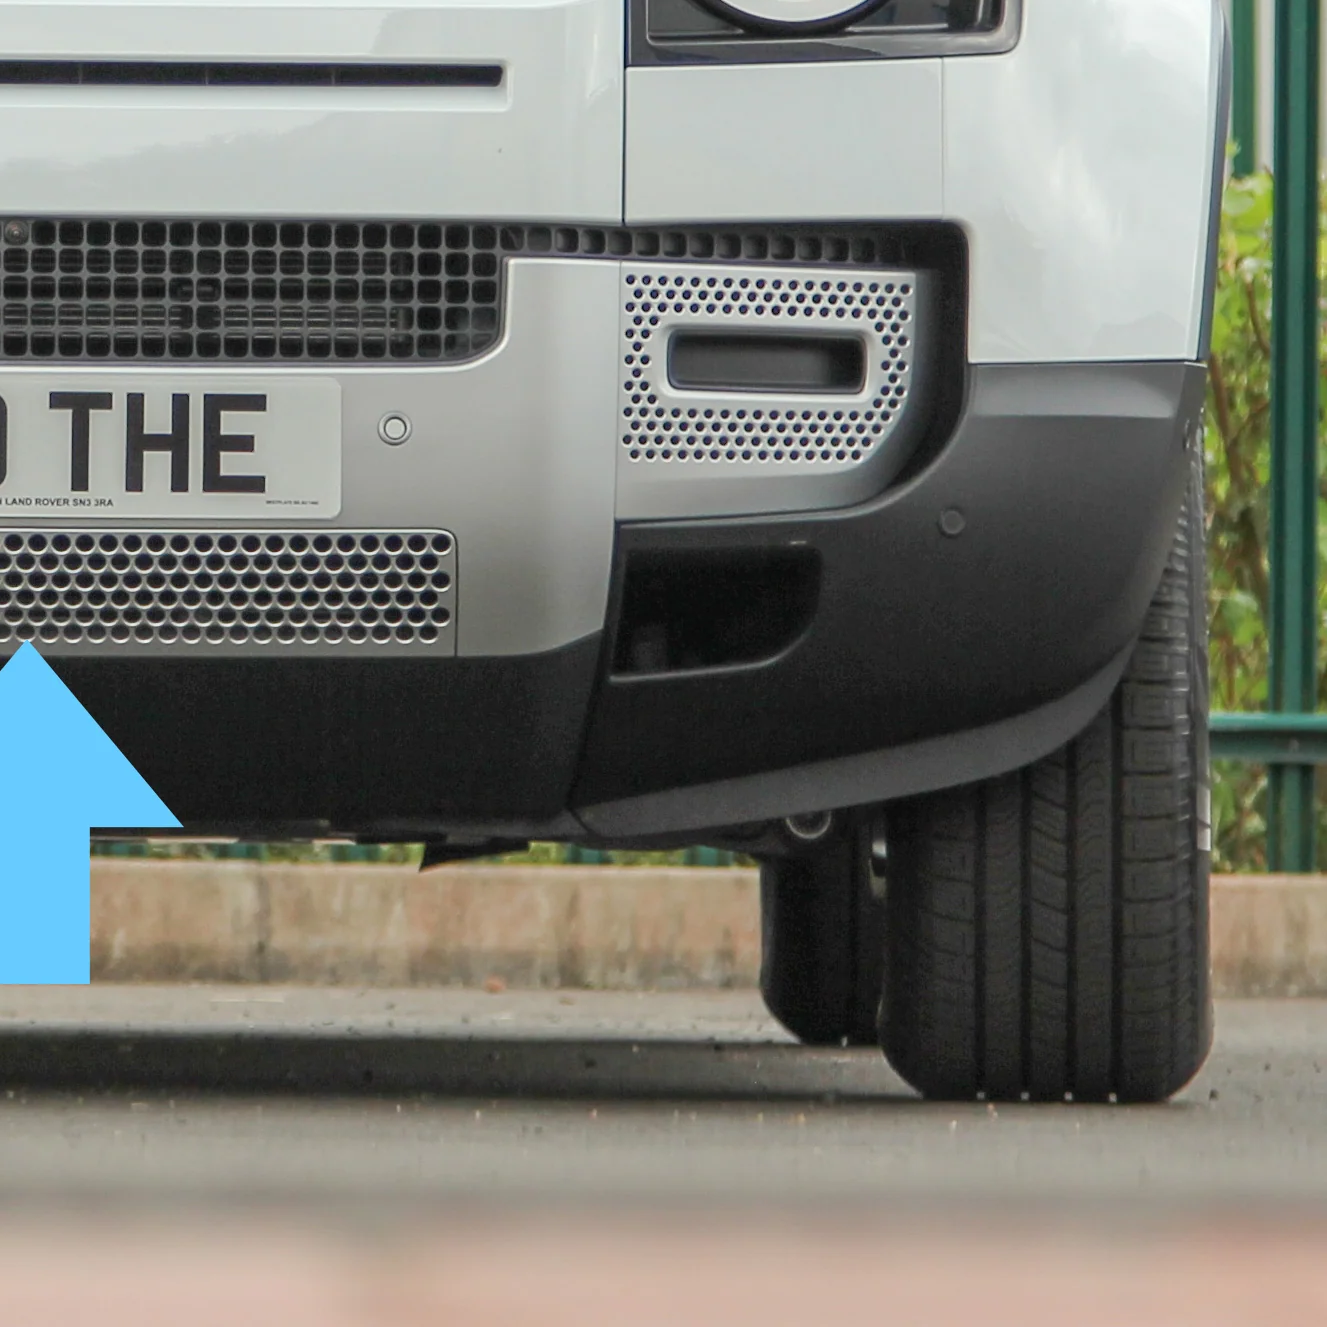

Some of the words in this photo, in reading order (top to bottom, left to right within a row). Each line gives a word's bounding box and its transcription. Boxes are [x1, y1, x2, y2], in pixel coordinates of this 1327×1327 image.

[49, 392, 267, 493] THE
[5, 497, 32, 506] LAND
[35, 498, 70, 507] ROVER
[72, 498, 91, 507] SN3
[94, 499, 114, 507] 3RA
